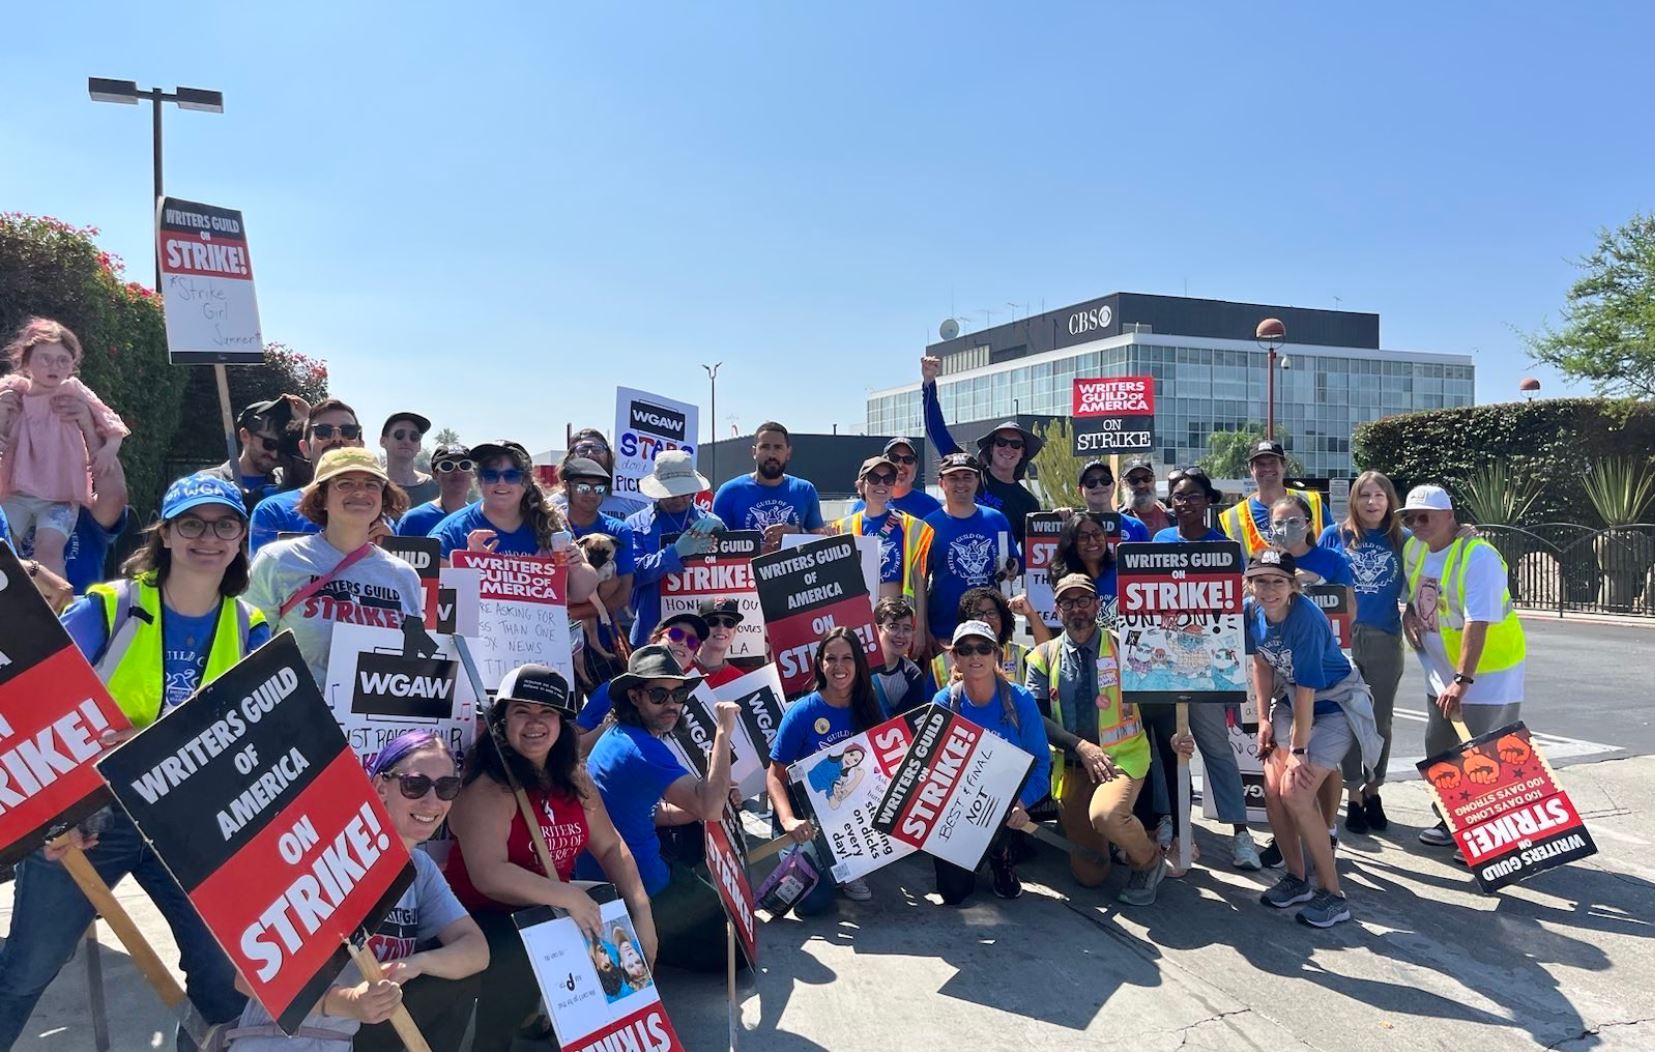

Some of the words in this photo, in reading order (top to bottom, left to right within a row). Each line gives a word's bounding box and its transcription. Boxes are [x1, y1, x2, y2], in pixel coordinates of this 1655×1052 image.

[165, 208, 210, 230] WRITERS
[211, 216, 240, 234] GUILD
[200, 231, 211, 241] ON
[166, 239, 248, 275] STRIKE!
[203, 302, 228, 320] Girl
[1069, 308, 1098, 335] CBS
[1078, 381, 1145, 394] WRITERS
[1081, 392, 1128, 403] GUILD
[1128, 393, 1144, 401] OF
[1078, 400, 1149, 413] AMERICA
[632, 409, 683, 432] WGAW
[1103, 419, 1122, 431] ON
[1077, 431, 1151, 450] STRIKE
[1032, 521, 1063, 533] WRIT
[720, 540, 755, 553] GUILD
[464, 556, 556, 576] WRITERS
[704, 555, 716, 564] ON
[758, 554, 816, 581] WRITERS
[816, 543, 852, 565] GUILD
[1125, 553, 1188, 568] WRITERS
[1191, 552, 1233, 567] GUILD
[532, 577, 551, 587] OF
[667, 563, 757, 592] STRIKE!
[803, 572, 817, 585] OF
[1172, 570, 1186, 580] ON
[364, 584, 400, 601] GUILD
[480, 582, 558, 600] MERICA
[787, 582, 843, 610] AMERICA
[1126, 580, 1235, 610] STRIKE!
[536, 609, 555, 626] FOR
[812, 614, 835, 635] ON
[497, 619, 528, 635] THAN
[534, 625, 555, 641] ONE
[508, 641, 543, 655] NEWS
[360, 671, 454, 699] WGAW
[748, 692, 777, 749] WGA
[131, 709, 246, 804] WRITERS
[241, 666, 298, 723] GUILD
[682, 705, 714, 757] WGA
[0, 698, 119, 816] RIKE!
[233, 743, 259, 775] OF
[878, 758, 922, 825] WRITERS
[915, 713, 945, 759] GUILD
[917, 767, 931, 782] ON
[902, 725, 977, 840] STRIKE!
[1496, 784, 1526, 798] DAYS
[1529, 777, 1545, 788] 100
[215, 747, 310, 841] AMERICA
[938, 796, 965, 843] BEST
[965, 750, 993, 788] FINAL
[1495, 796, 1524, 811] DAYS
[1524, 789, 1543, 801] 100
[965, 785, 990, 825] NOT
[1455, 796, 1495, 816] STRONG
[853, 809, 865, 825] on
[1465, 808, 1495, 824] LONG
[541, 822, 582, 838] RITERS
[1462, 798, 1570, 858] STRIKE!
[278, 815, 321, 865] ON
[832, 832, 852, 860] day!
[843, 822, 863, 857] every
[861, 827, 880, 860] dicks
[1517, 838, 1532, 850] ON
[1524, 834, 1586, 865] WRITERS
[1482, 857, 1522, 881] GUILD
[240, 802, 391, 984] STRIKE!
